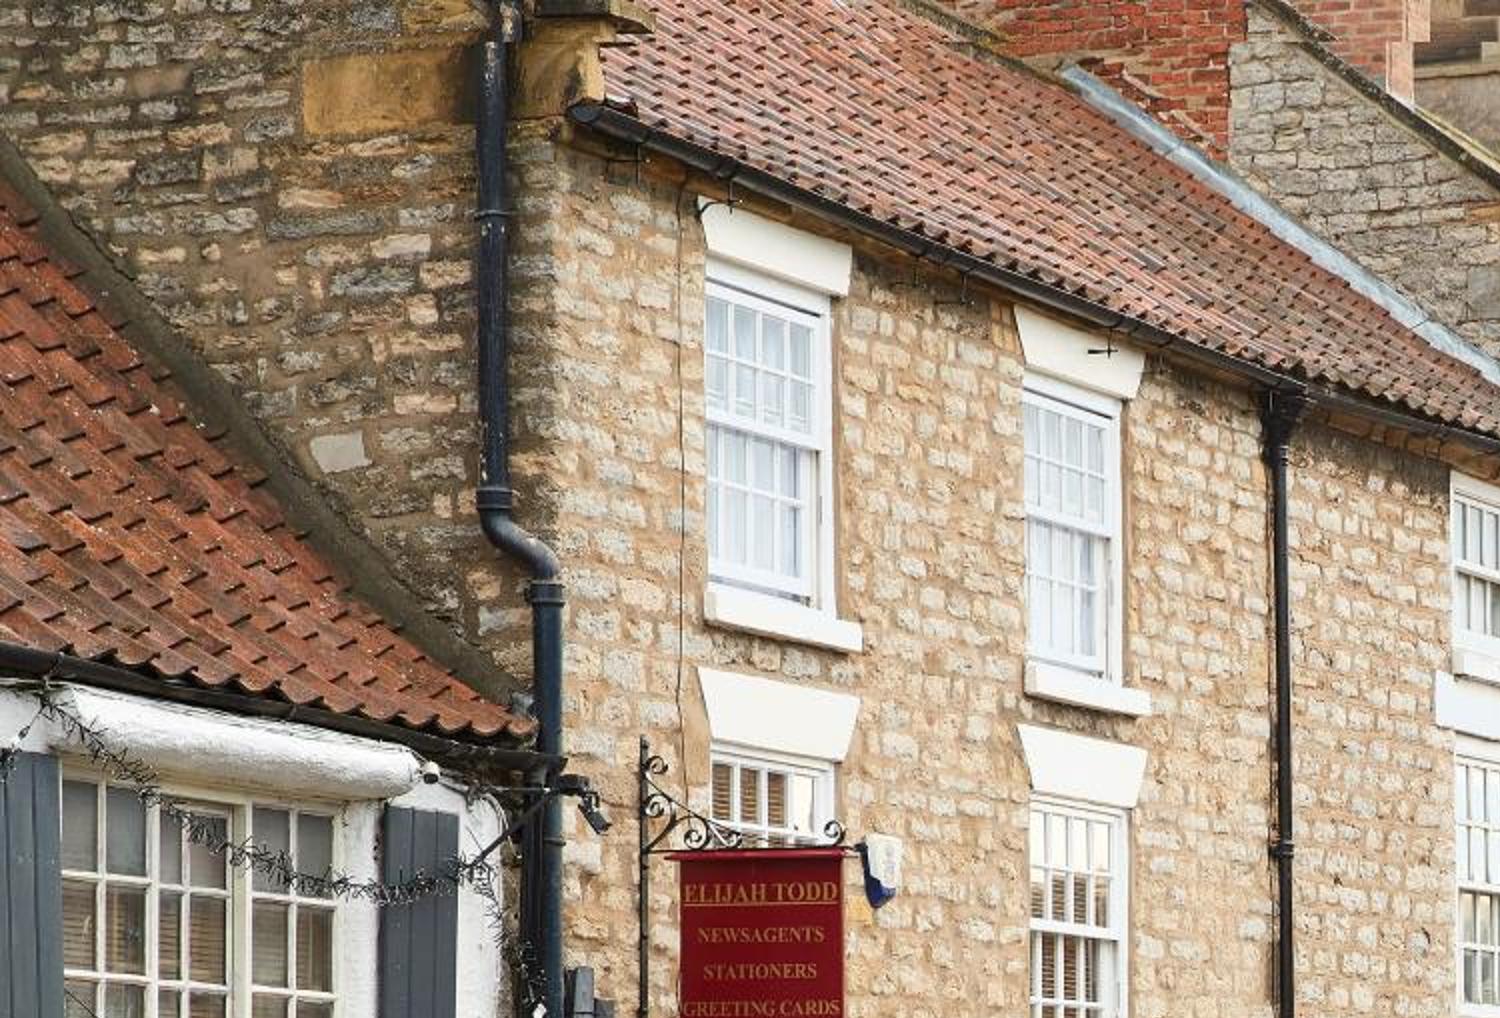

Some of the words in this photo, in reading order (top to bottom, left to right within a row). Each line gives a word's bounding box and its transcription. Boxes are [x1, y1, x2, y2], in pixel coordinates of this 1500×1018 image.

[684, 883, 766, 903] ELIJAH
[772, 881, 839, 901] TODD
[698, 927, 825, 944] NEWSAGENTS
[703, 963, 817, 981] STATIONERS
[683, 1001, 775, 1017] GREETING
[780, 1000, 841, 1016] CARDS
